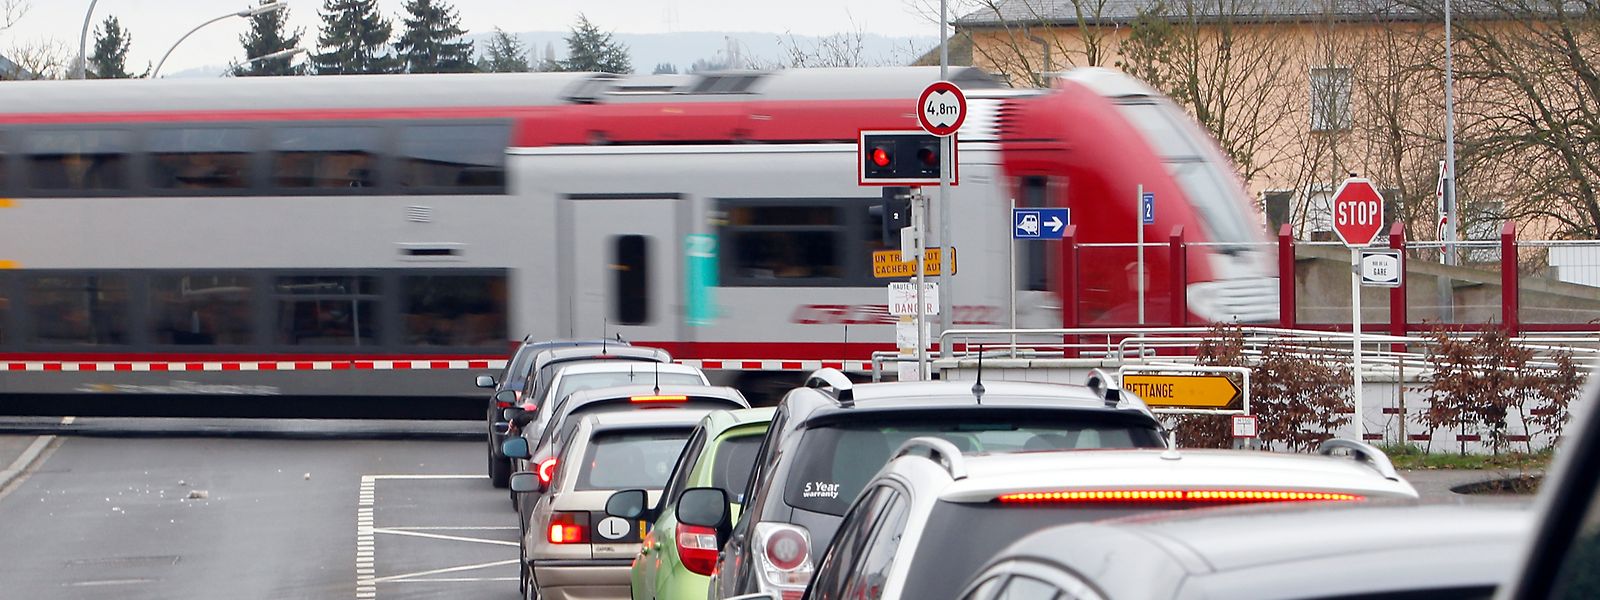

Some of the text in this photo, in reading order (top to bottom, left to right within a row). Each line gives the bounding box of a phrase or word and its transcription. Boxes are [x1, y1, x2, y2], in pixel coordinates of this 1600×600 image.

[927, 101, 957, 116] 4,8m
[1146, 203, 1151, 217] 2
[1338, 201, 1377, 225] STOP
[875, 264, 908, 273] CACHER
[1373, 268, 1387, 276] GARE
[895, 303, 933, 313] DANGR
[804, 481, 840, 492] 5 Year
[610, 520, 620, 535] L
